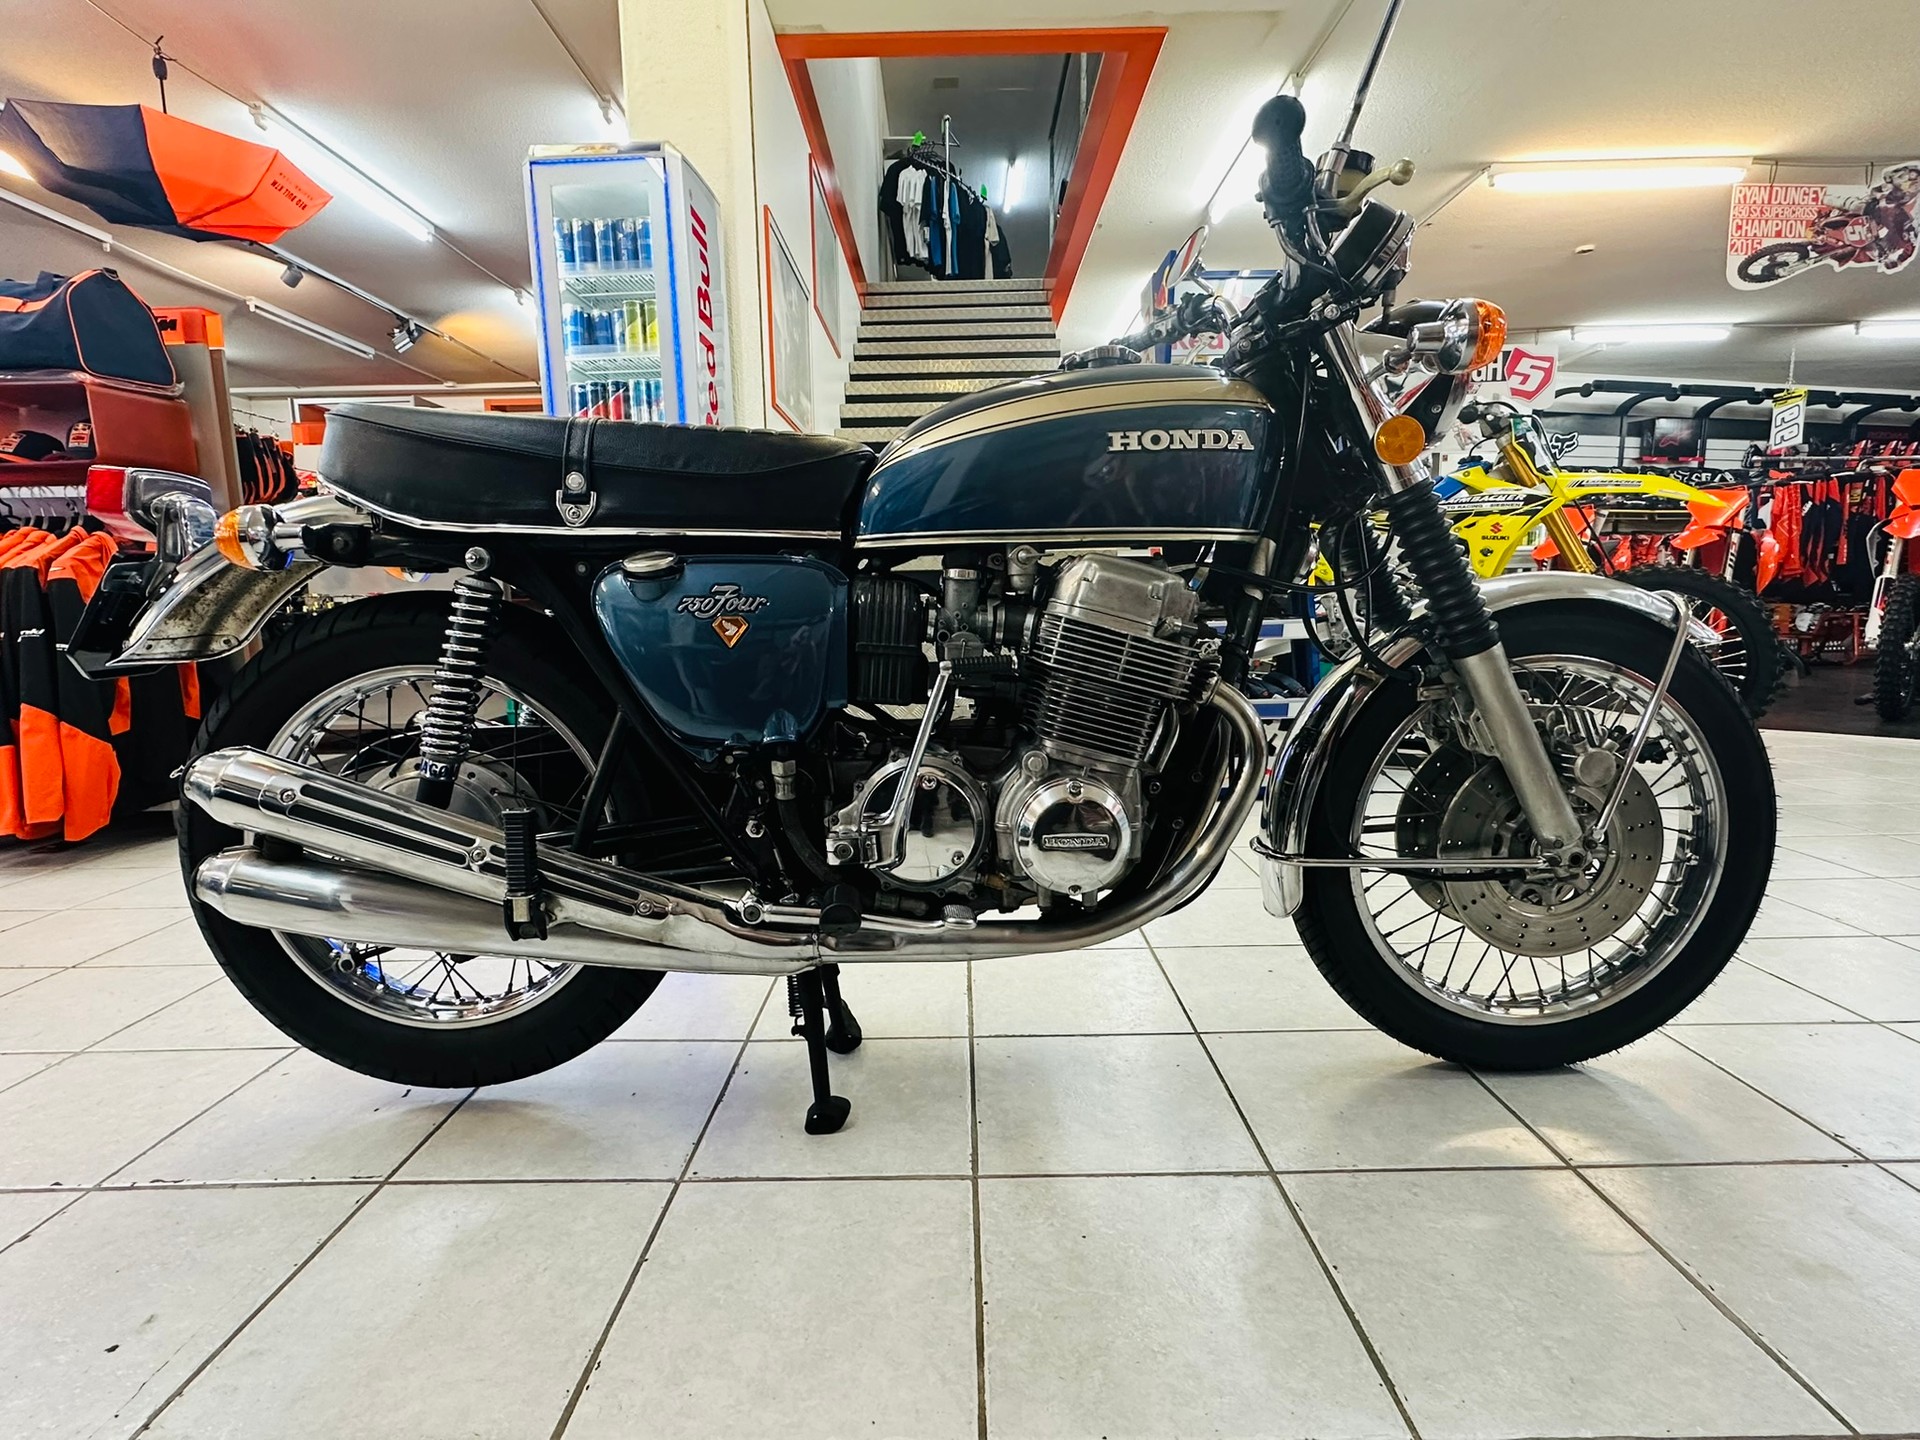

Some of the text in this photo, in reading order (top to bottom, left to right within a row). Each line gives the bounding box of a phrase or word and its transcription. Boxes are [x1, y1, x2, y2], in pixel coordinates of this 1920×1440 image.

[1735, 186, 1826, 205] RYAN DUNGEY
[1733, 206, 1819, 219] 450 SX SUPERCROSS
[1732, 219, 1806, 238] CHAMPION
[1731, 240, 1761, 255] 2015
[690, 204, 714, 332] Bull
[1508, 356, 1552, 392] 5
[1107, 429, 1255, 451] HONDA
[677, 584, 768, 618] 750 Four
[1044, 837, 1107, 848] HONDA
